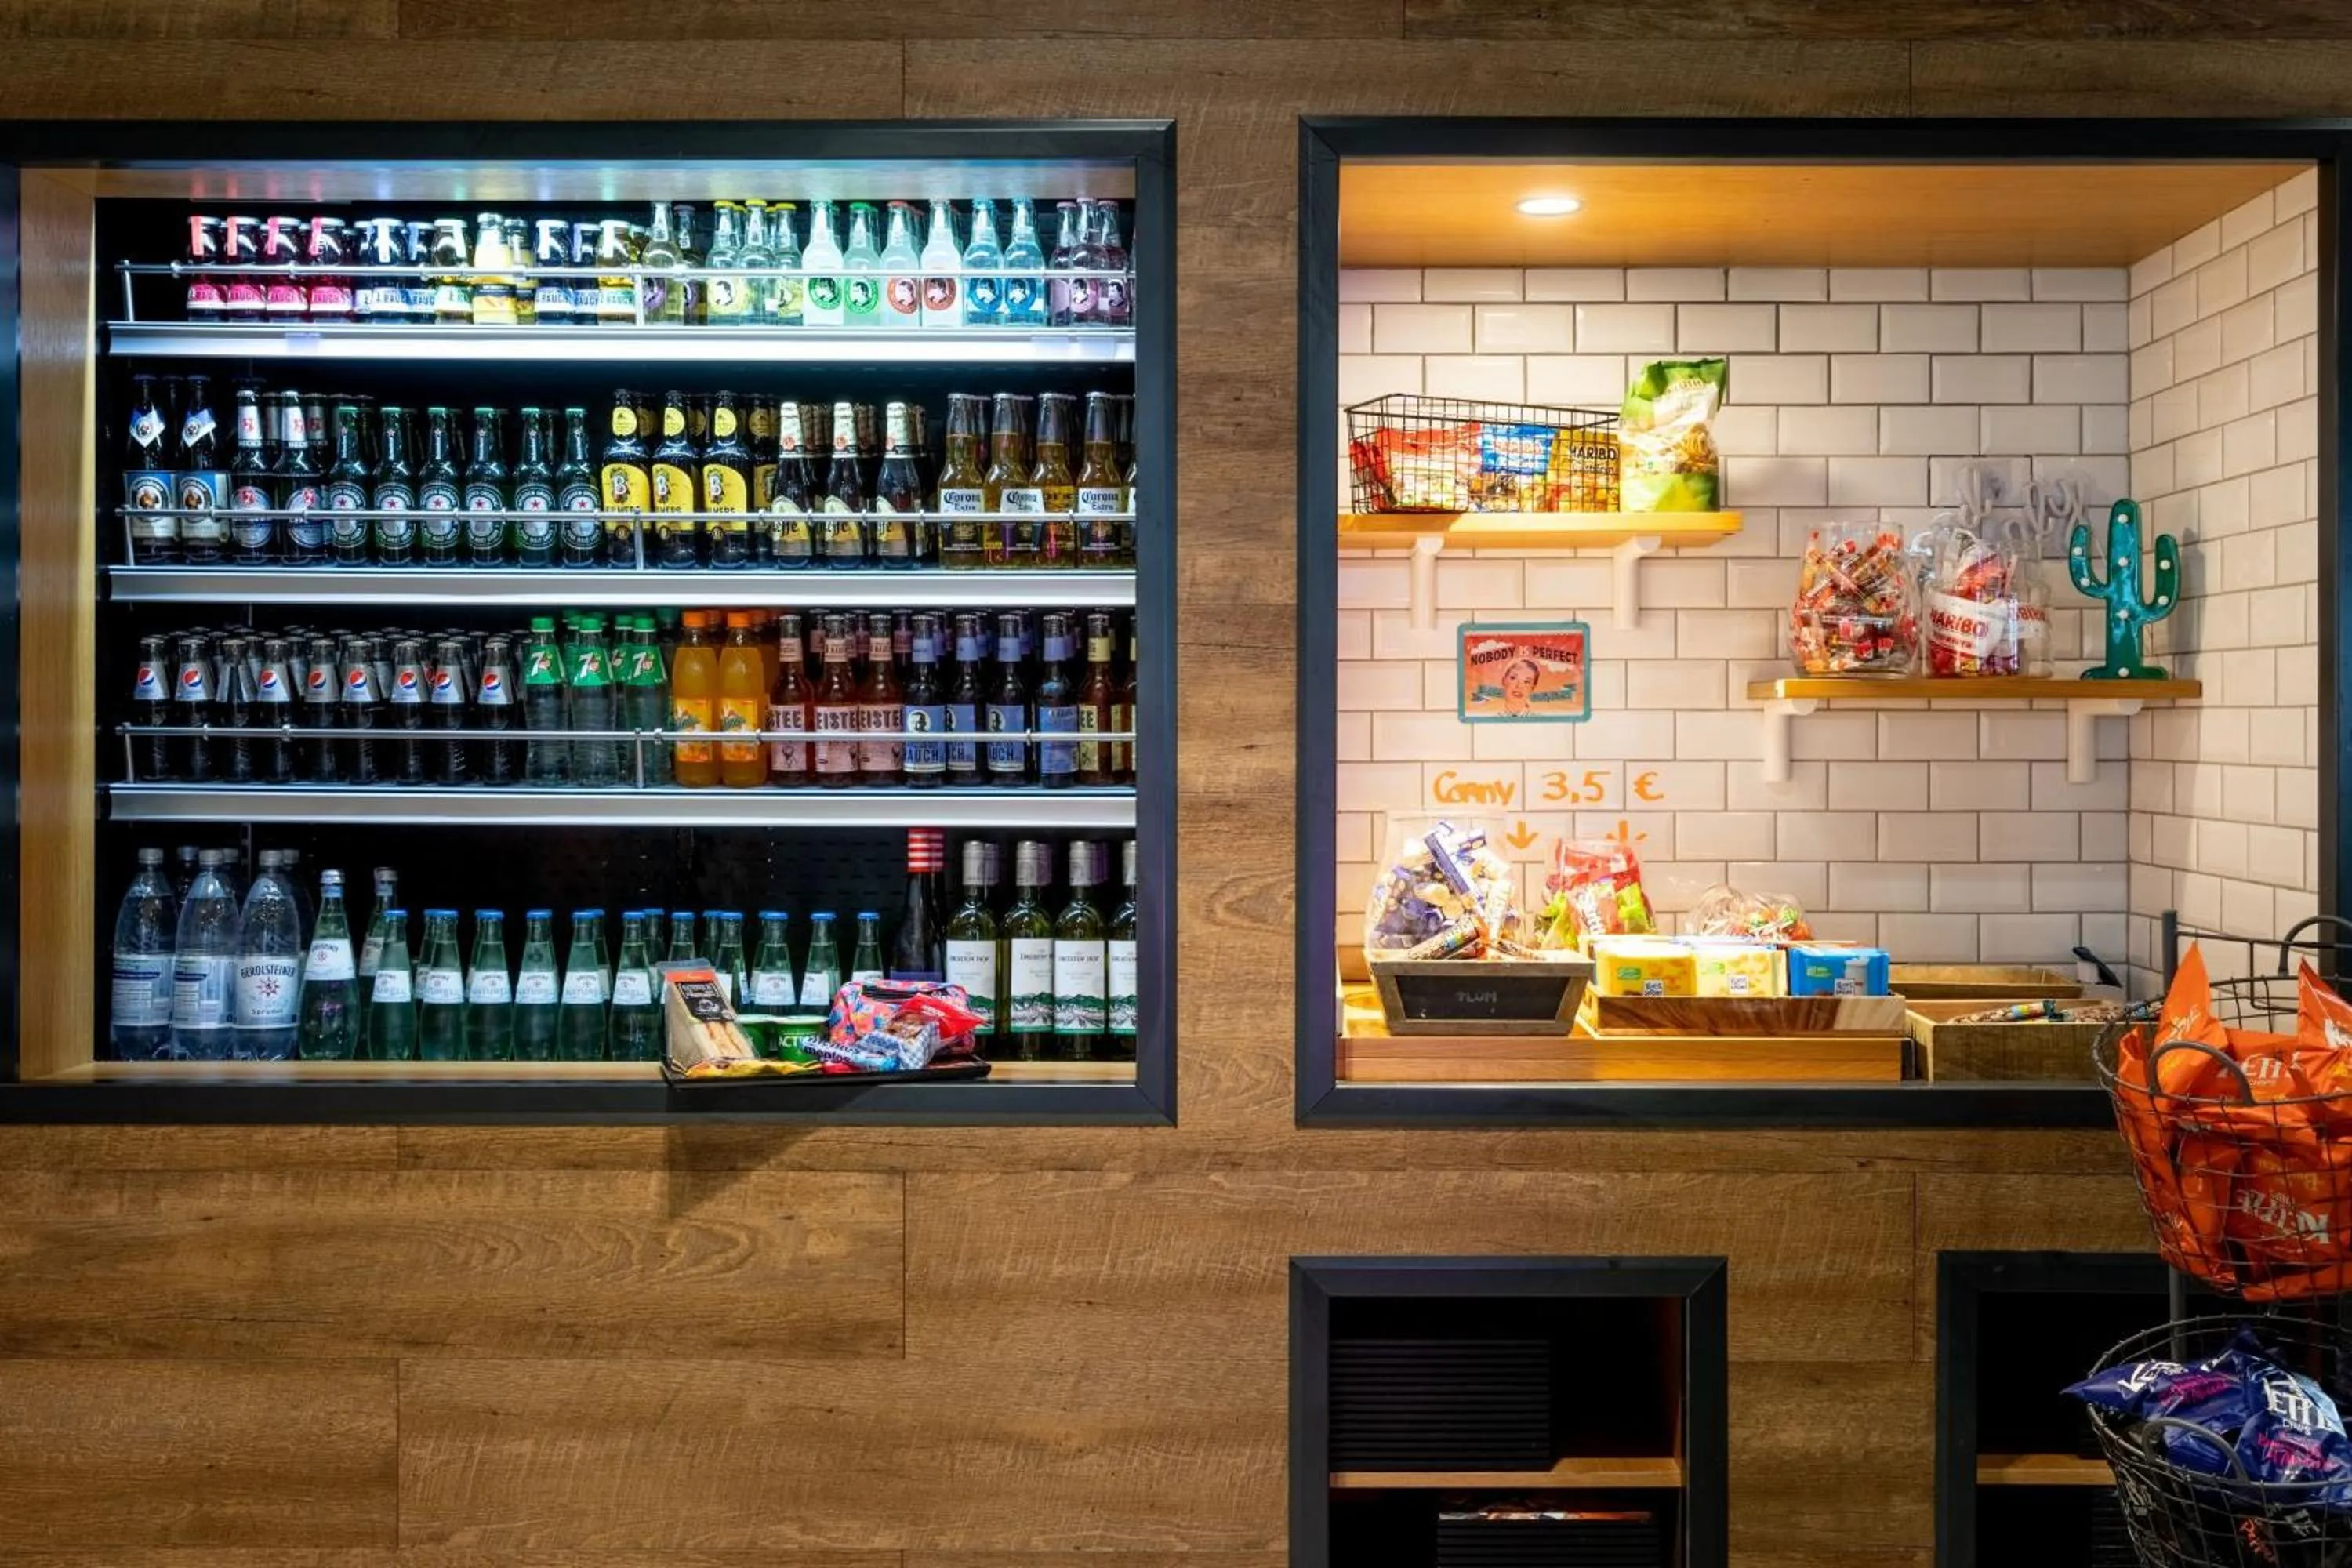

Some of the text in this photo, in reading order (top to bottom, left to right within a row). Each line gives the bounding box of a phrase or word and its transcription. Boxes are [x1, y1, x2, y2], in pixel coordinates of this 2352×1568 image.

[1470, 646, 1515, 666] NOBODY
[1532, 645, 1579, 664] PERFECT
[1541, 771, 1611, 804] 3,5
[1633, 771, 1664, 801] €
